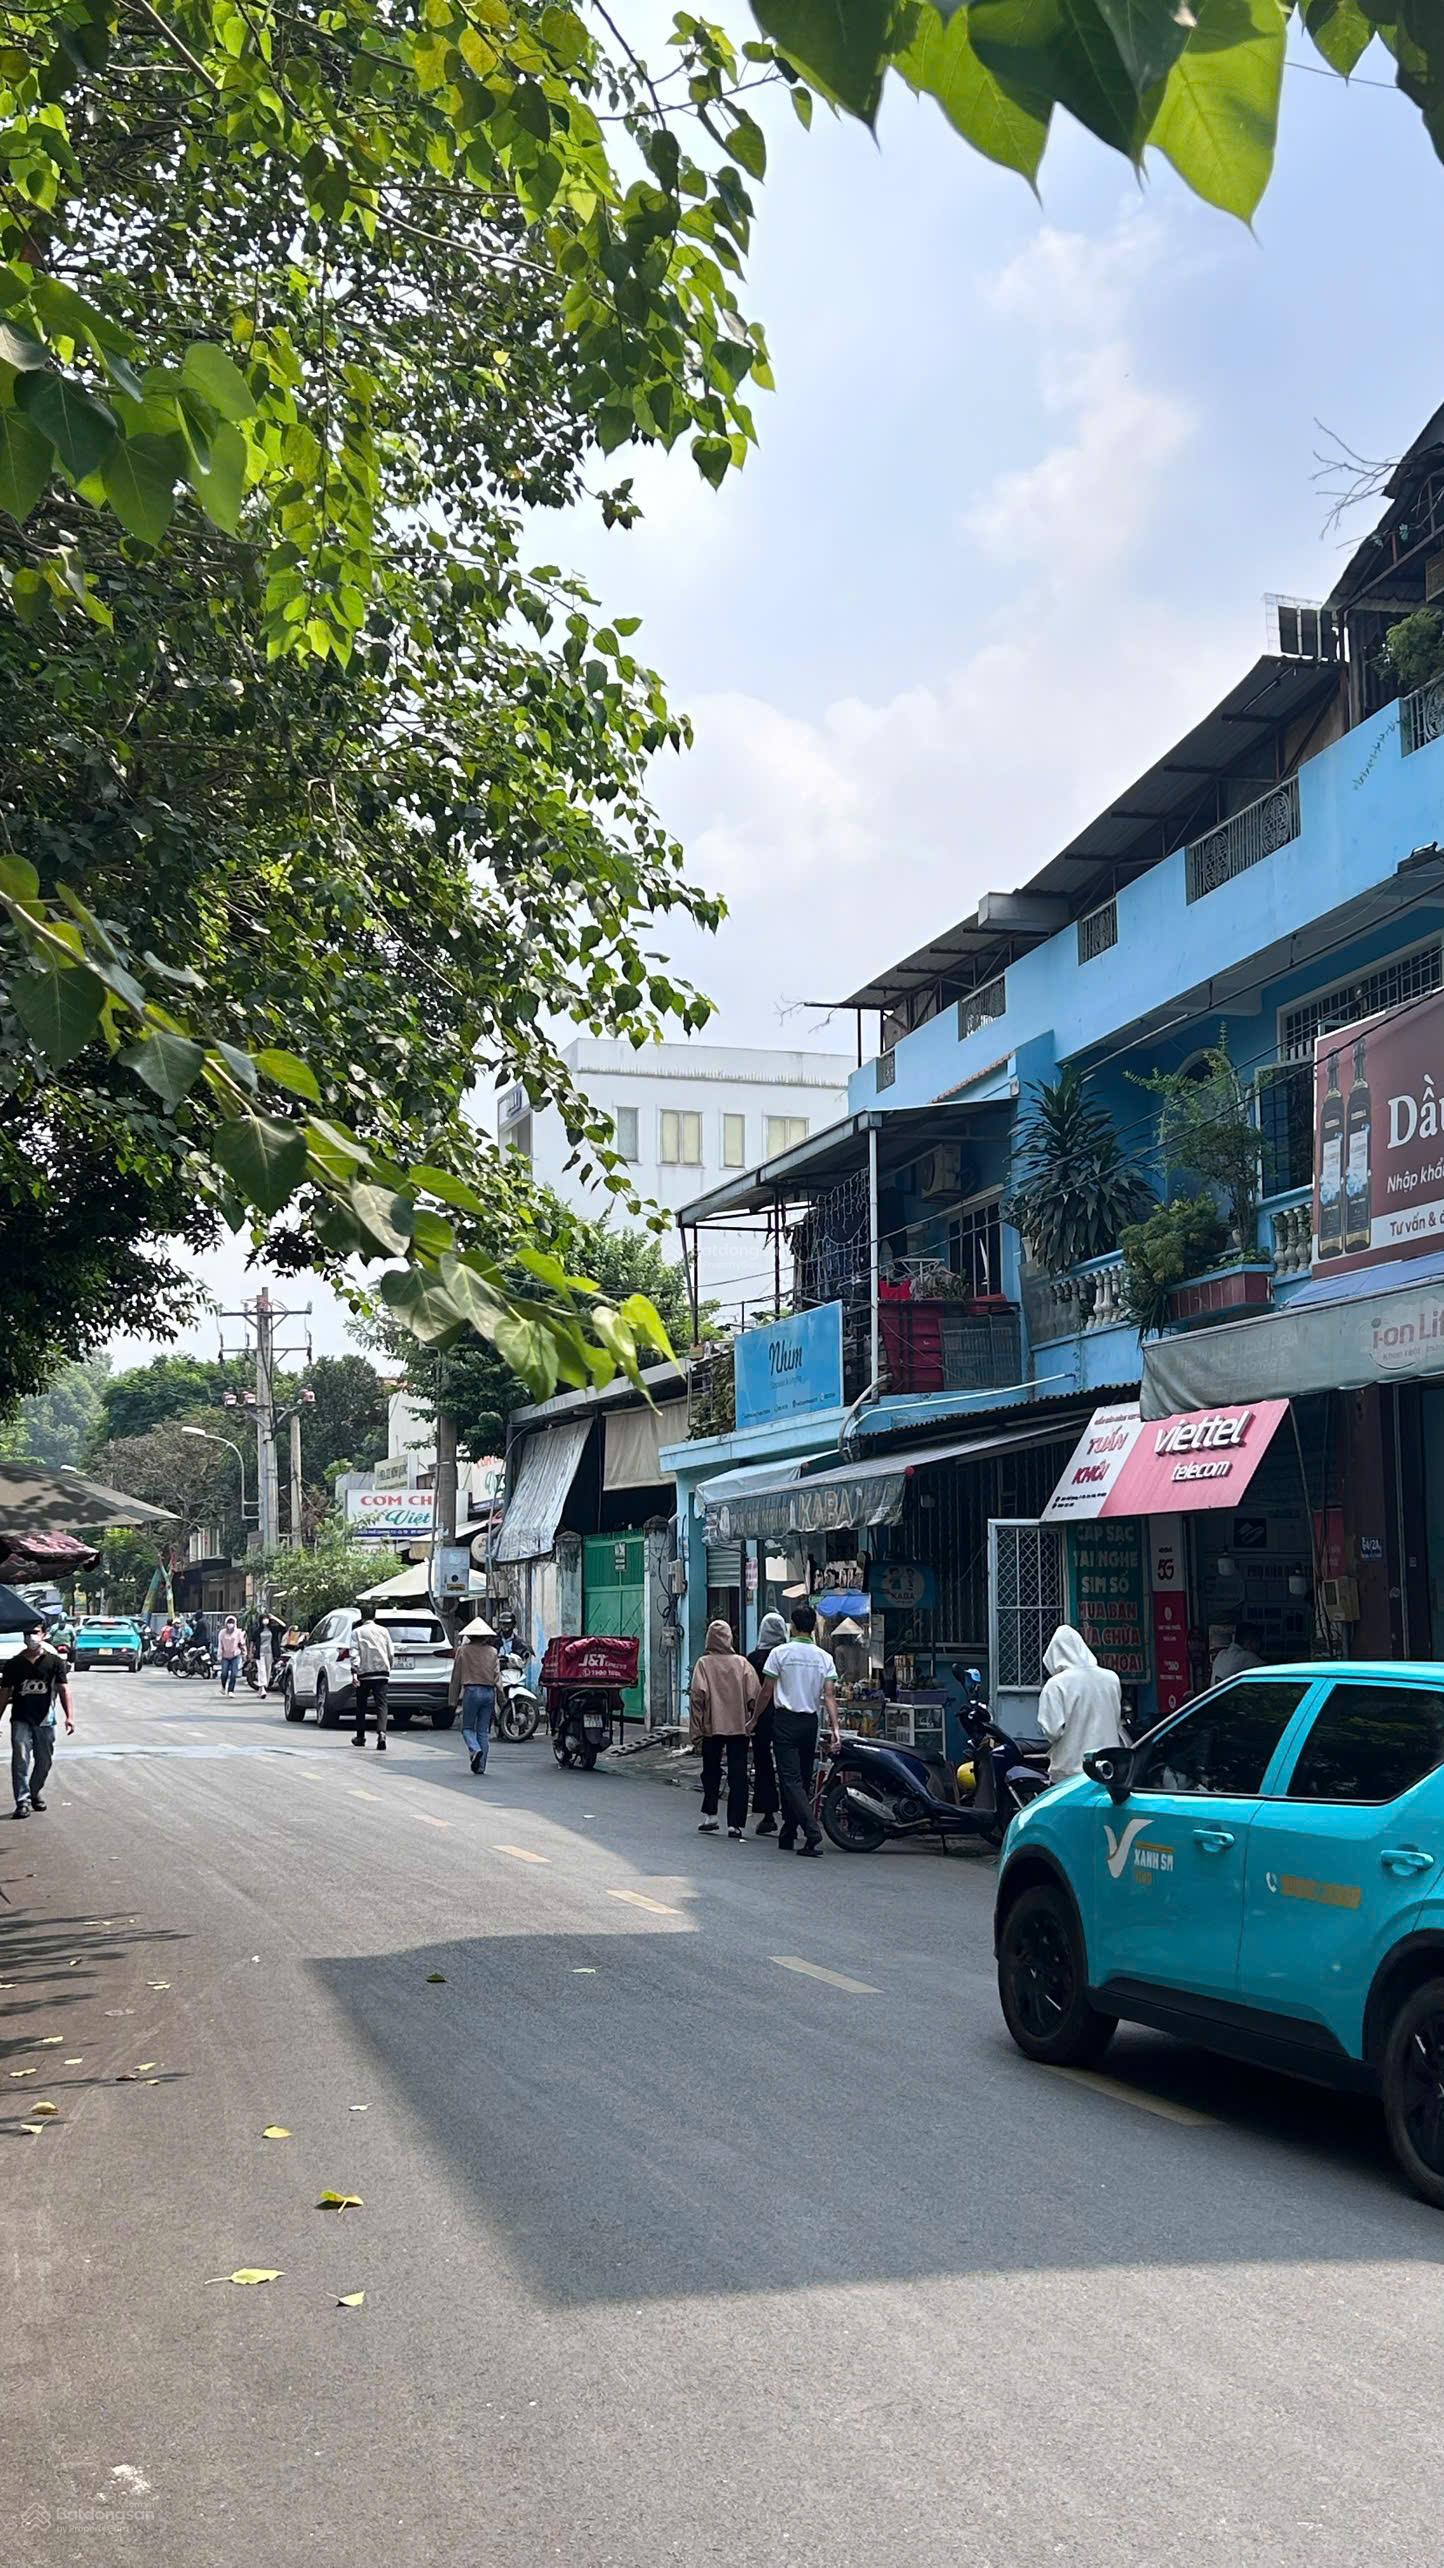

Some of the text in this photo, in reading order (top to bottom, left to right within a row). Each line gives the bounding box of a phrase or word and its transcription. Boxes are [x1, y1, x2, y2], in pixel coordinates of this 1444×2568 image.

[1387, 1157, 1444, 1193] Nhập khẩ
[1390, 1221, 1404, 1237] Tư
[1405, 1212, 1426, 1232] vấn
[1428, 1211, 1437, 1227] &
[1154, 1410, 1251, 1454] viettel
[1171, 1459, 1232, 1482] telecom
[360, 1494, 432, 1506] CƠM CH
[385, 1509, 430, 1526] Việt
[1096, 1551, 1138, 1568] NGHE
[1157, 1558, 1175, 1581] 5G
[1081, 1576, 1107, 1594] SIM
[1081, 1621, 1101, 1646] ỬA
[578, 1654, 608, 1667] J&T
[1134, 1848, 1174, 1872] XANH SM
